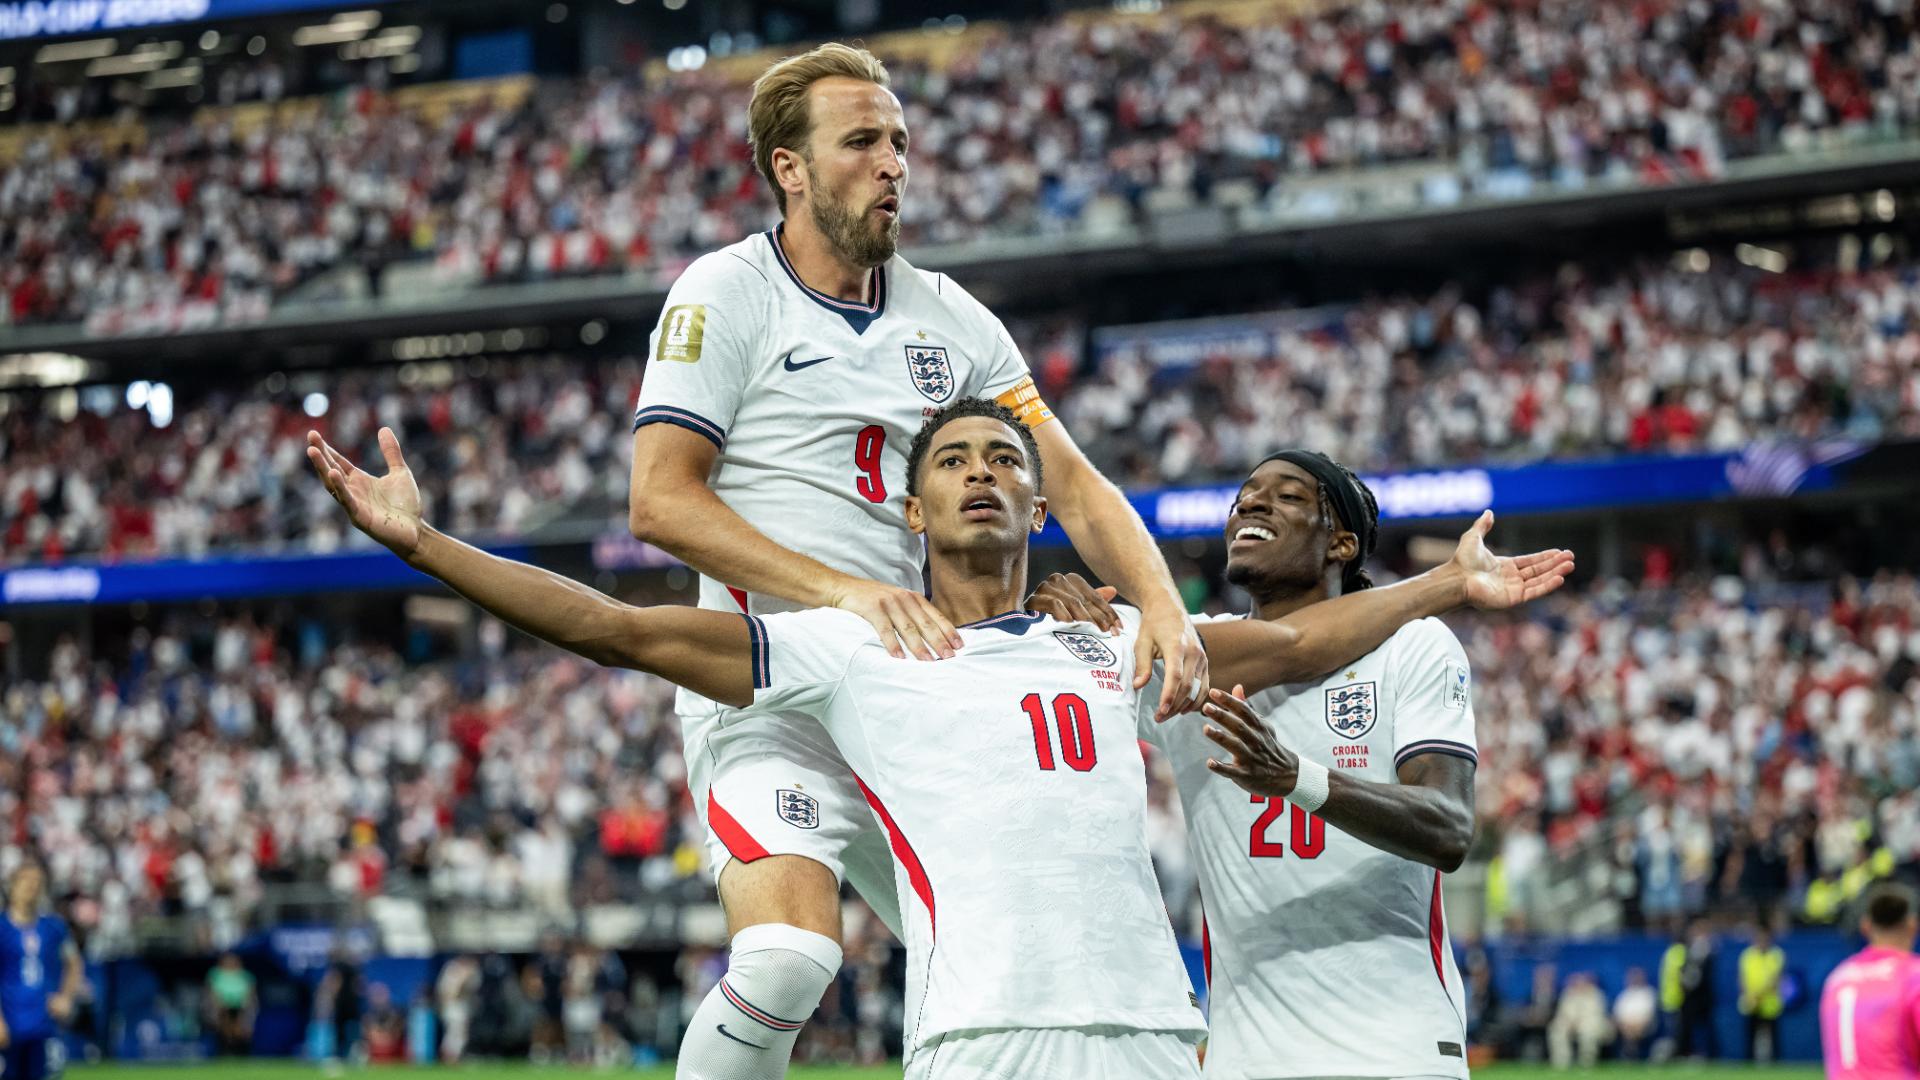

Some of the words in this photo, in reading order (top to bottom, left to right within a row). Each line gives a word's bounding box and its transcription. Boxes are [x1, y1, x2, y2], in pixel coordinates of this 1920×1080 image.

[855, 424, 888, 504] 9
[1020, 693, 1098, 772] 10
[1332, 745, 1369, 756] CROATIA
[1337, 758, 1368, 768] 17.06.26
[1250, 793, 1325, 859] 20
[1837, 986, 1858, 1070] 1
